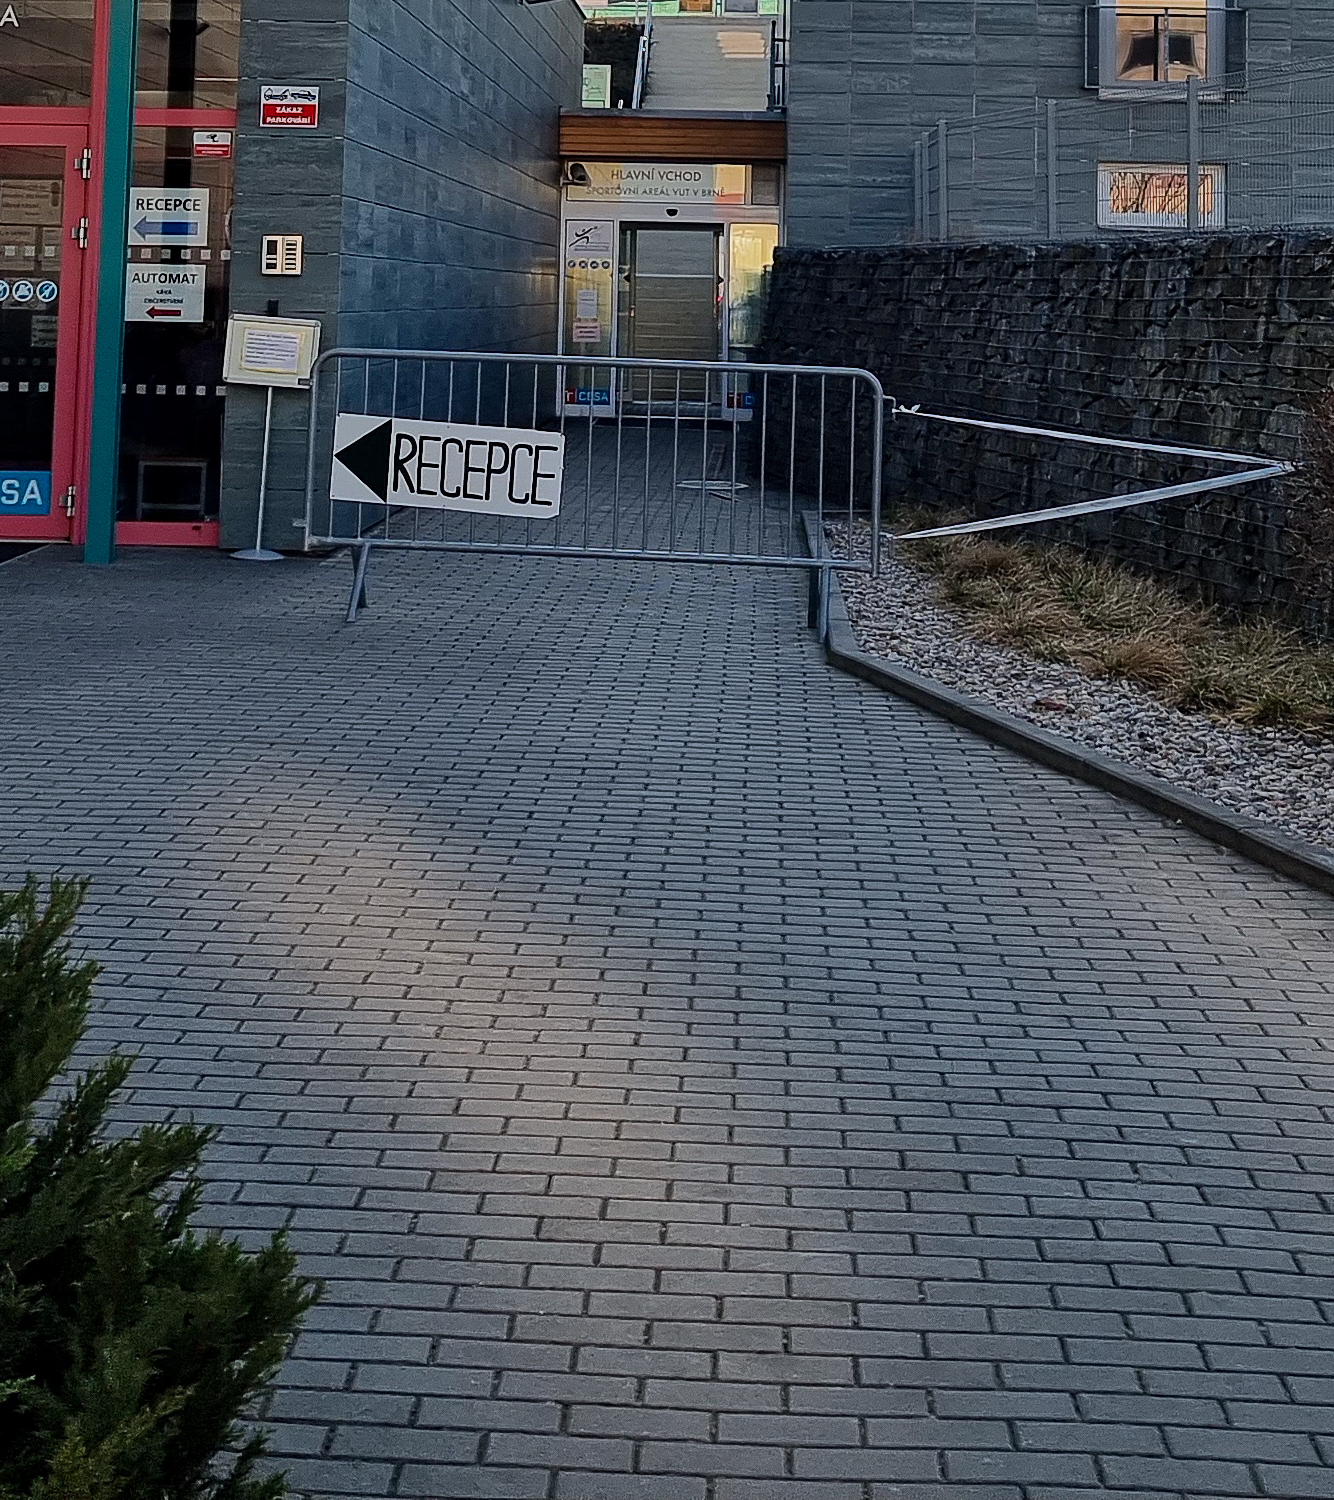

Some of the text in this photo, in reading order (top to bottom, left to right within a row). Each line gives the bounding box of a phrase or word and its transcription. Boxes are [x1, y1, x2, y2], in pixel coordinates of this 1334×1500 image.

[275, 105, 303, 115] ZÁKAZ
[611, 168, 702, 182] HLAVNÍ VCHOD
[586, 184, 725, 198] SPORTOVNÍ AREÁL VUT V BRNĚ
[136, 198, 202, 212] RECEPCE
[132, 273, 199, 285] AUTOMAT
[392, 432, 559, 506] RECEPCE
